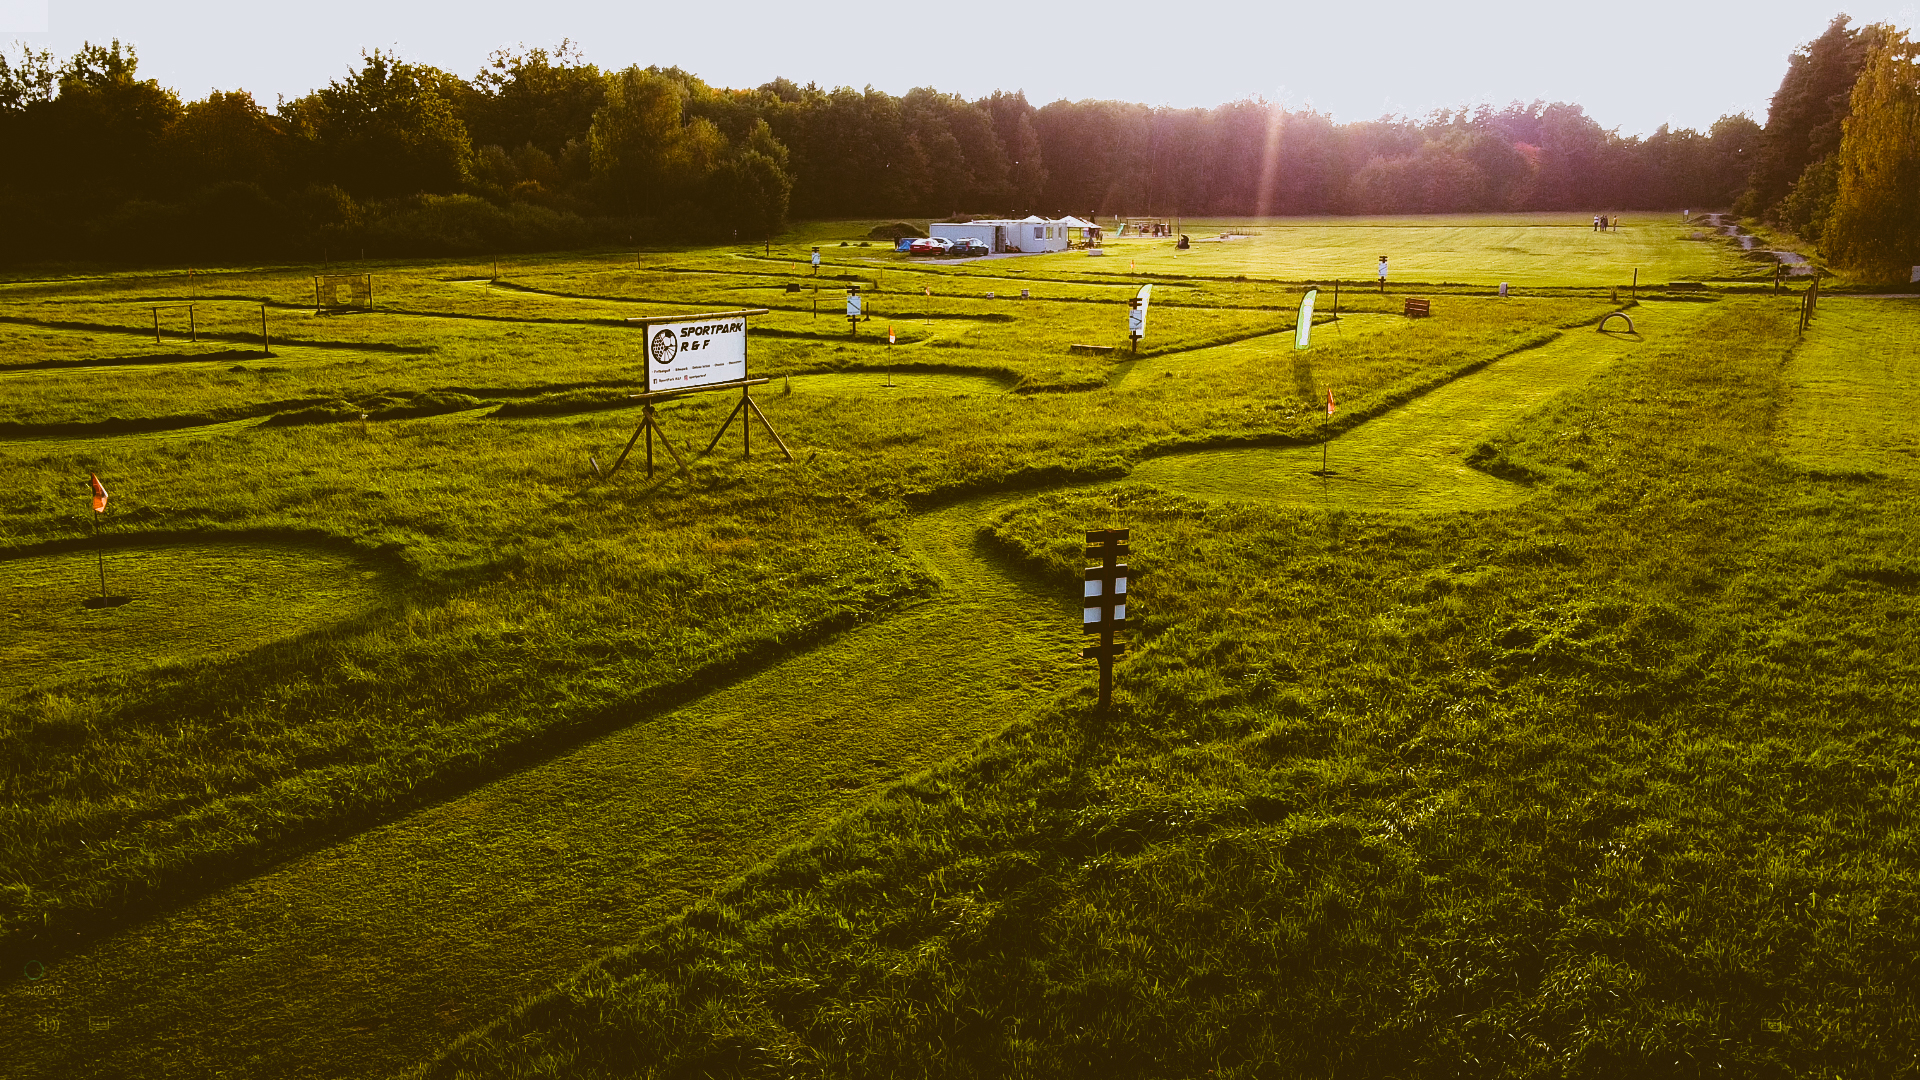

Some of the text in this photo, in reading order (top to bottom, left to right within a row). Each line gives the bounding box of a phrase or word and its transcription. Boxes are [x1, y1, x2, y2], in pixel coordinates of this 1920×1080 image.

[680, 322, 743, 337] SPORTPARK
[680, 339, 711, 352] R & F
